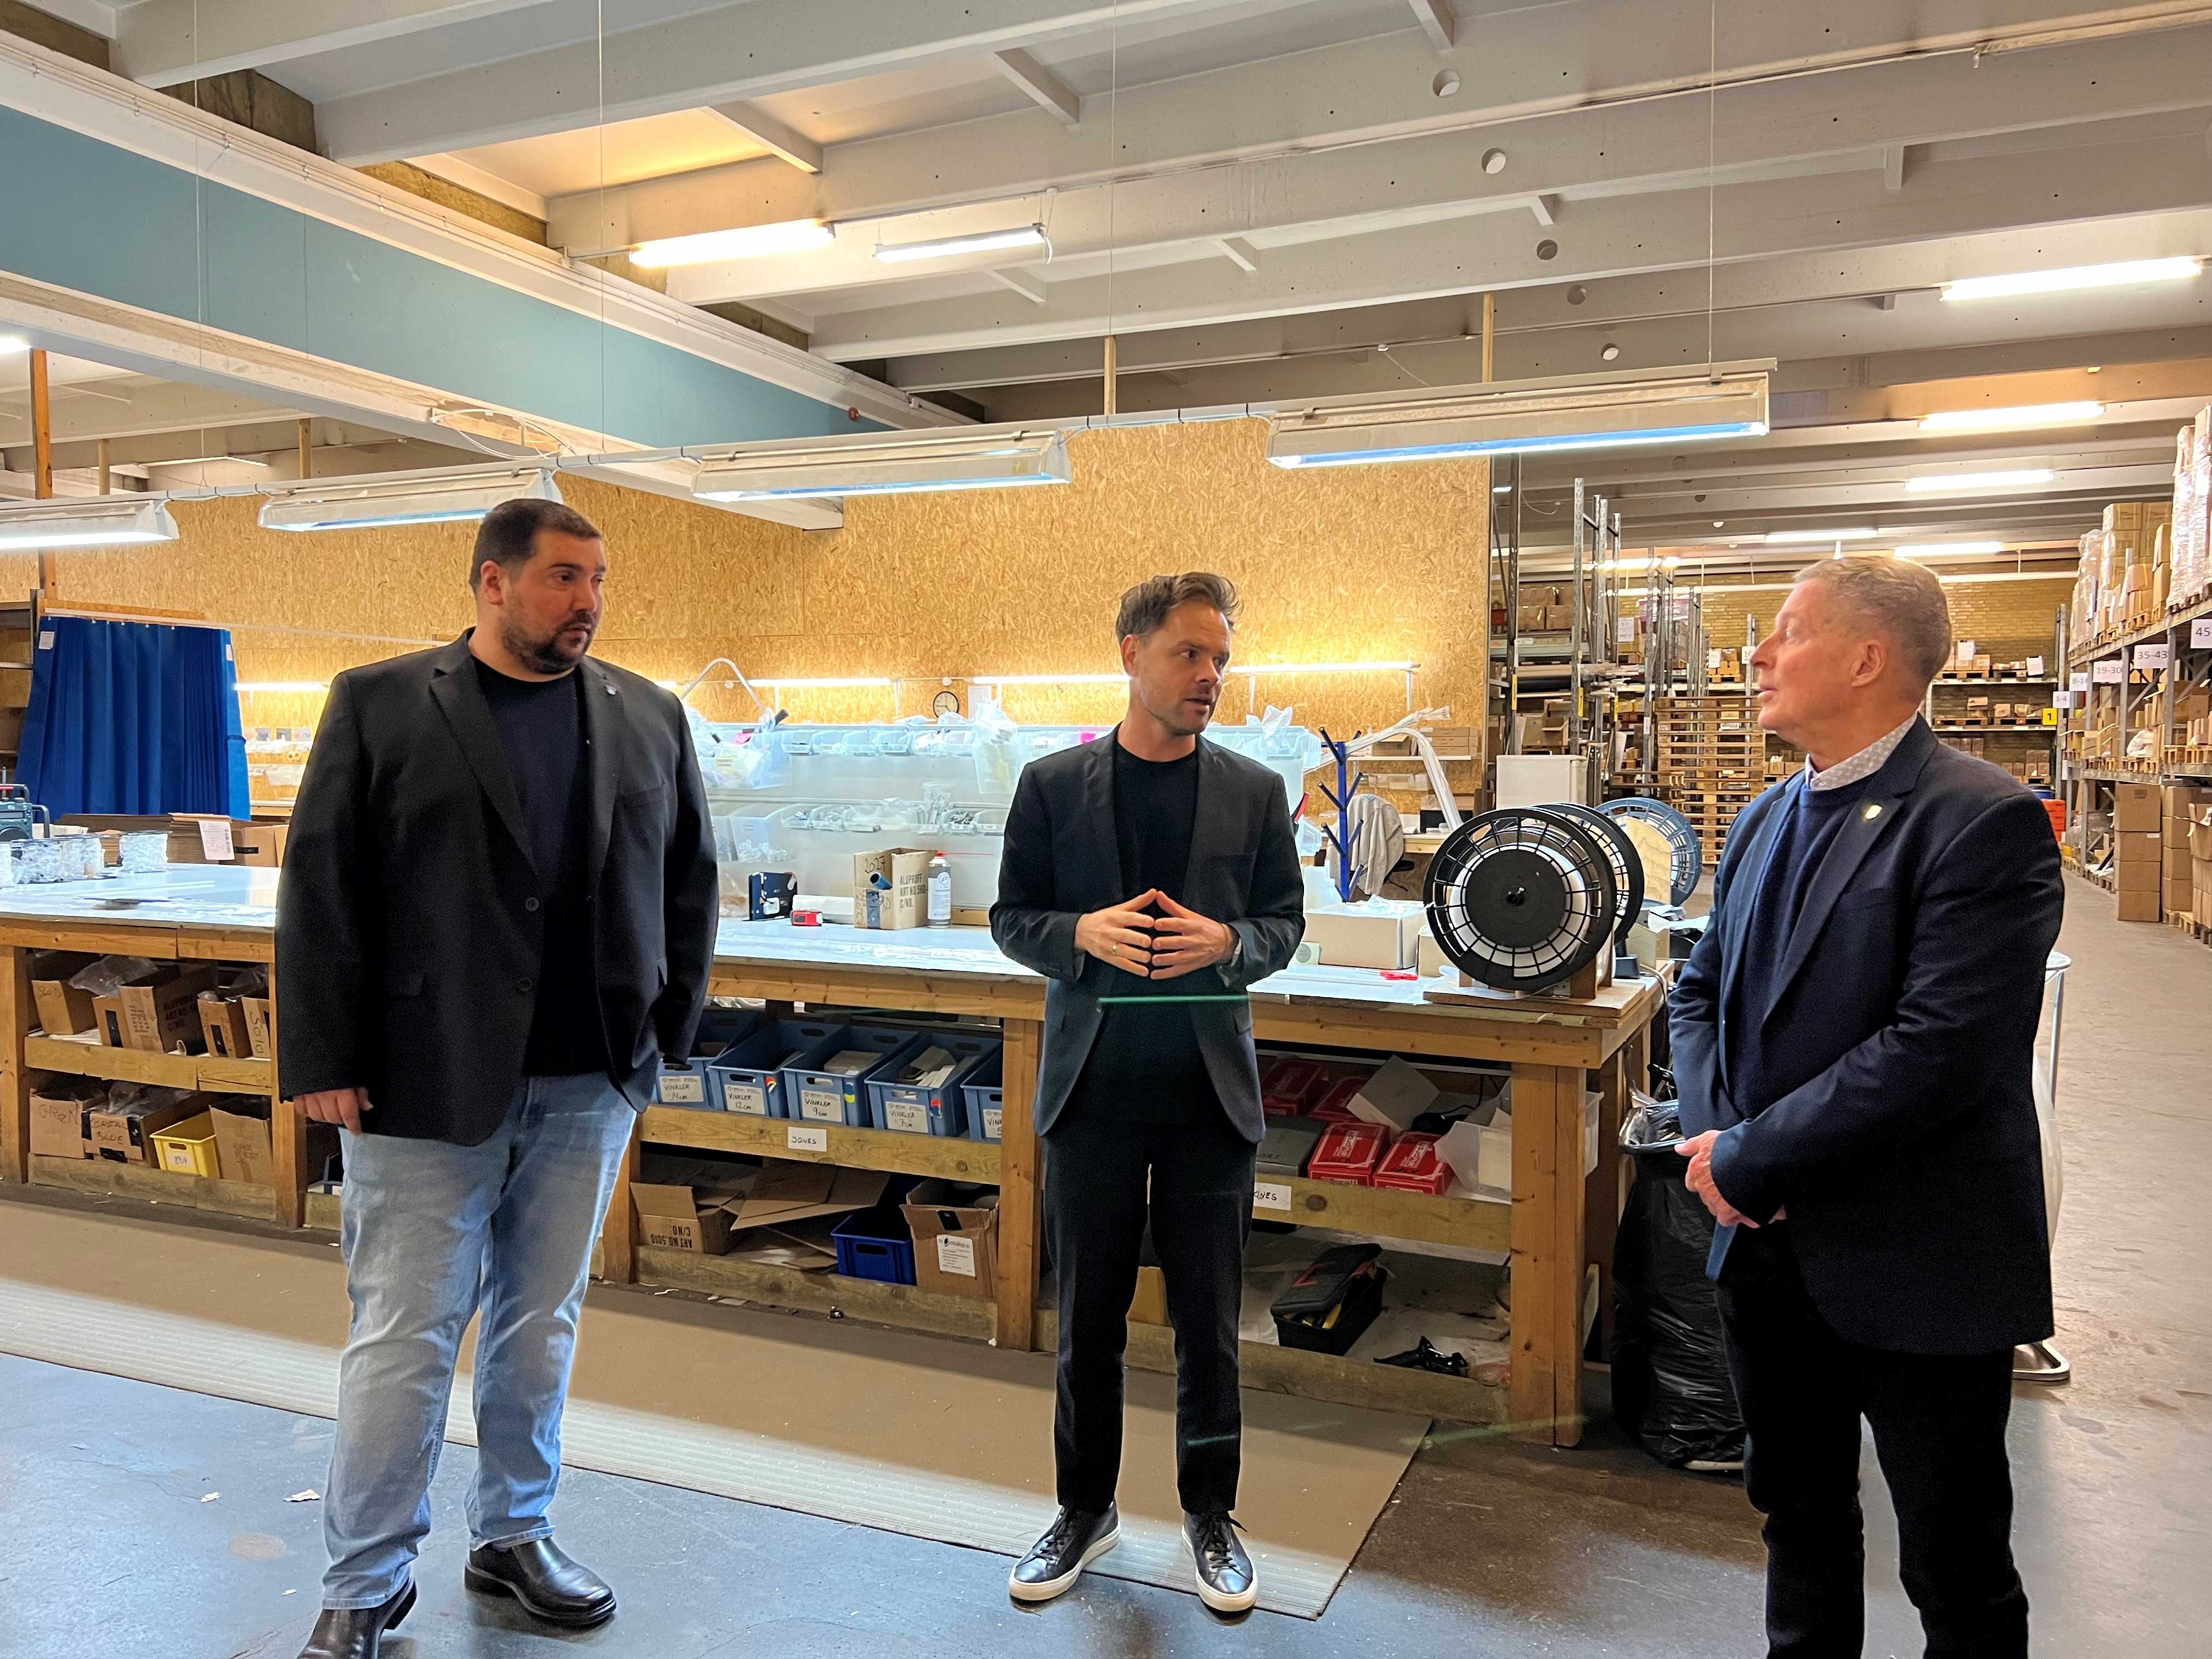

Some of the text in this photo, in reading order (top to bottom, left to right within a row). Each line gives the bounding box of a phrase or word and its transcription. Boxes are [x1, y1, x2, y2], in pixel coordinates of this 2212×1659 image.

[2195, 627, 2212, 636] 45
[2137, 650, 2167, 660] 35-43
[2047, 713, 2051, 721] 1
[864, 855, 887, 873] 2027
[900, 873, 922, 885] ALUPROFF
[900, 887, 909, 896] ART
[1254, 1190, 1277, 1201] ONES
[680, 1238, 692, 1249] ART
